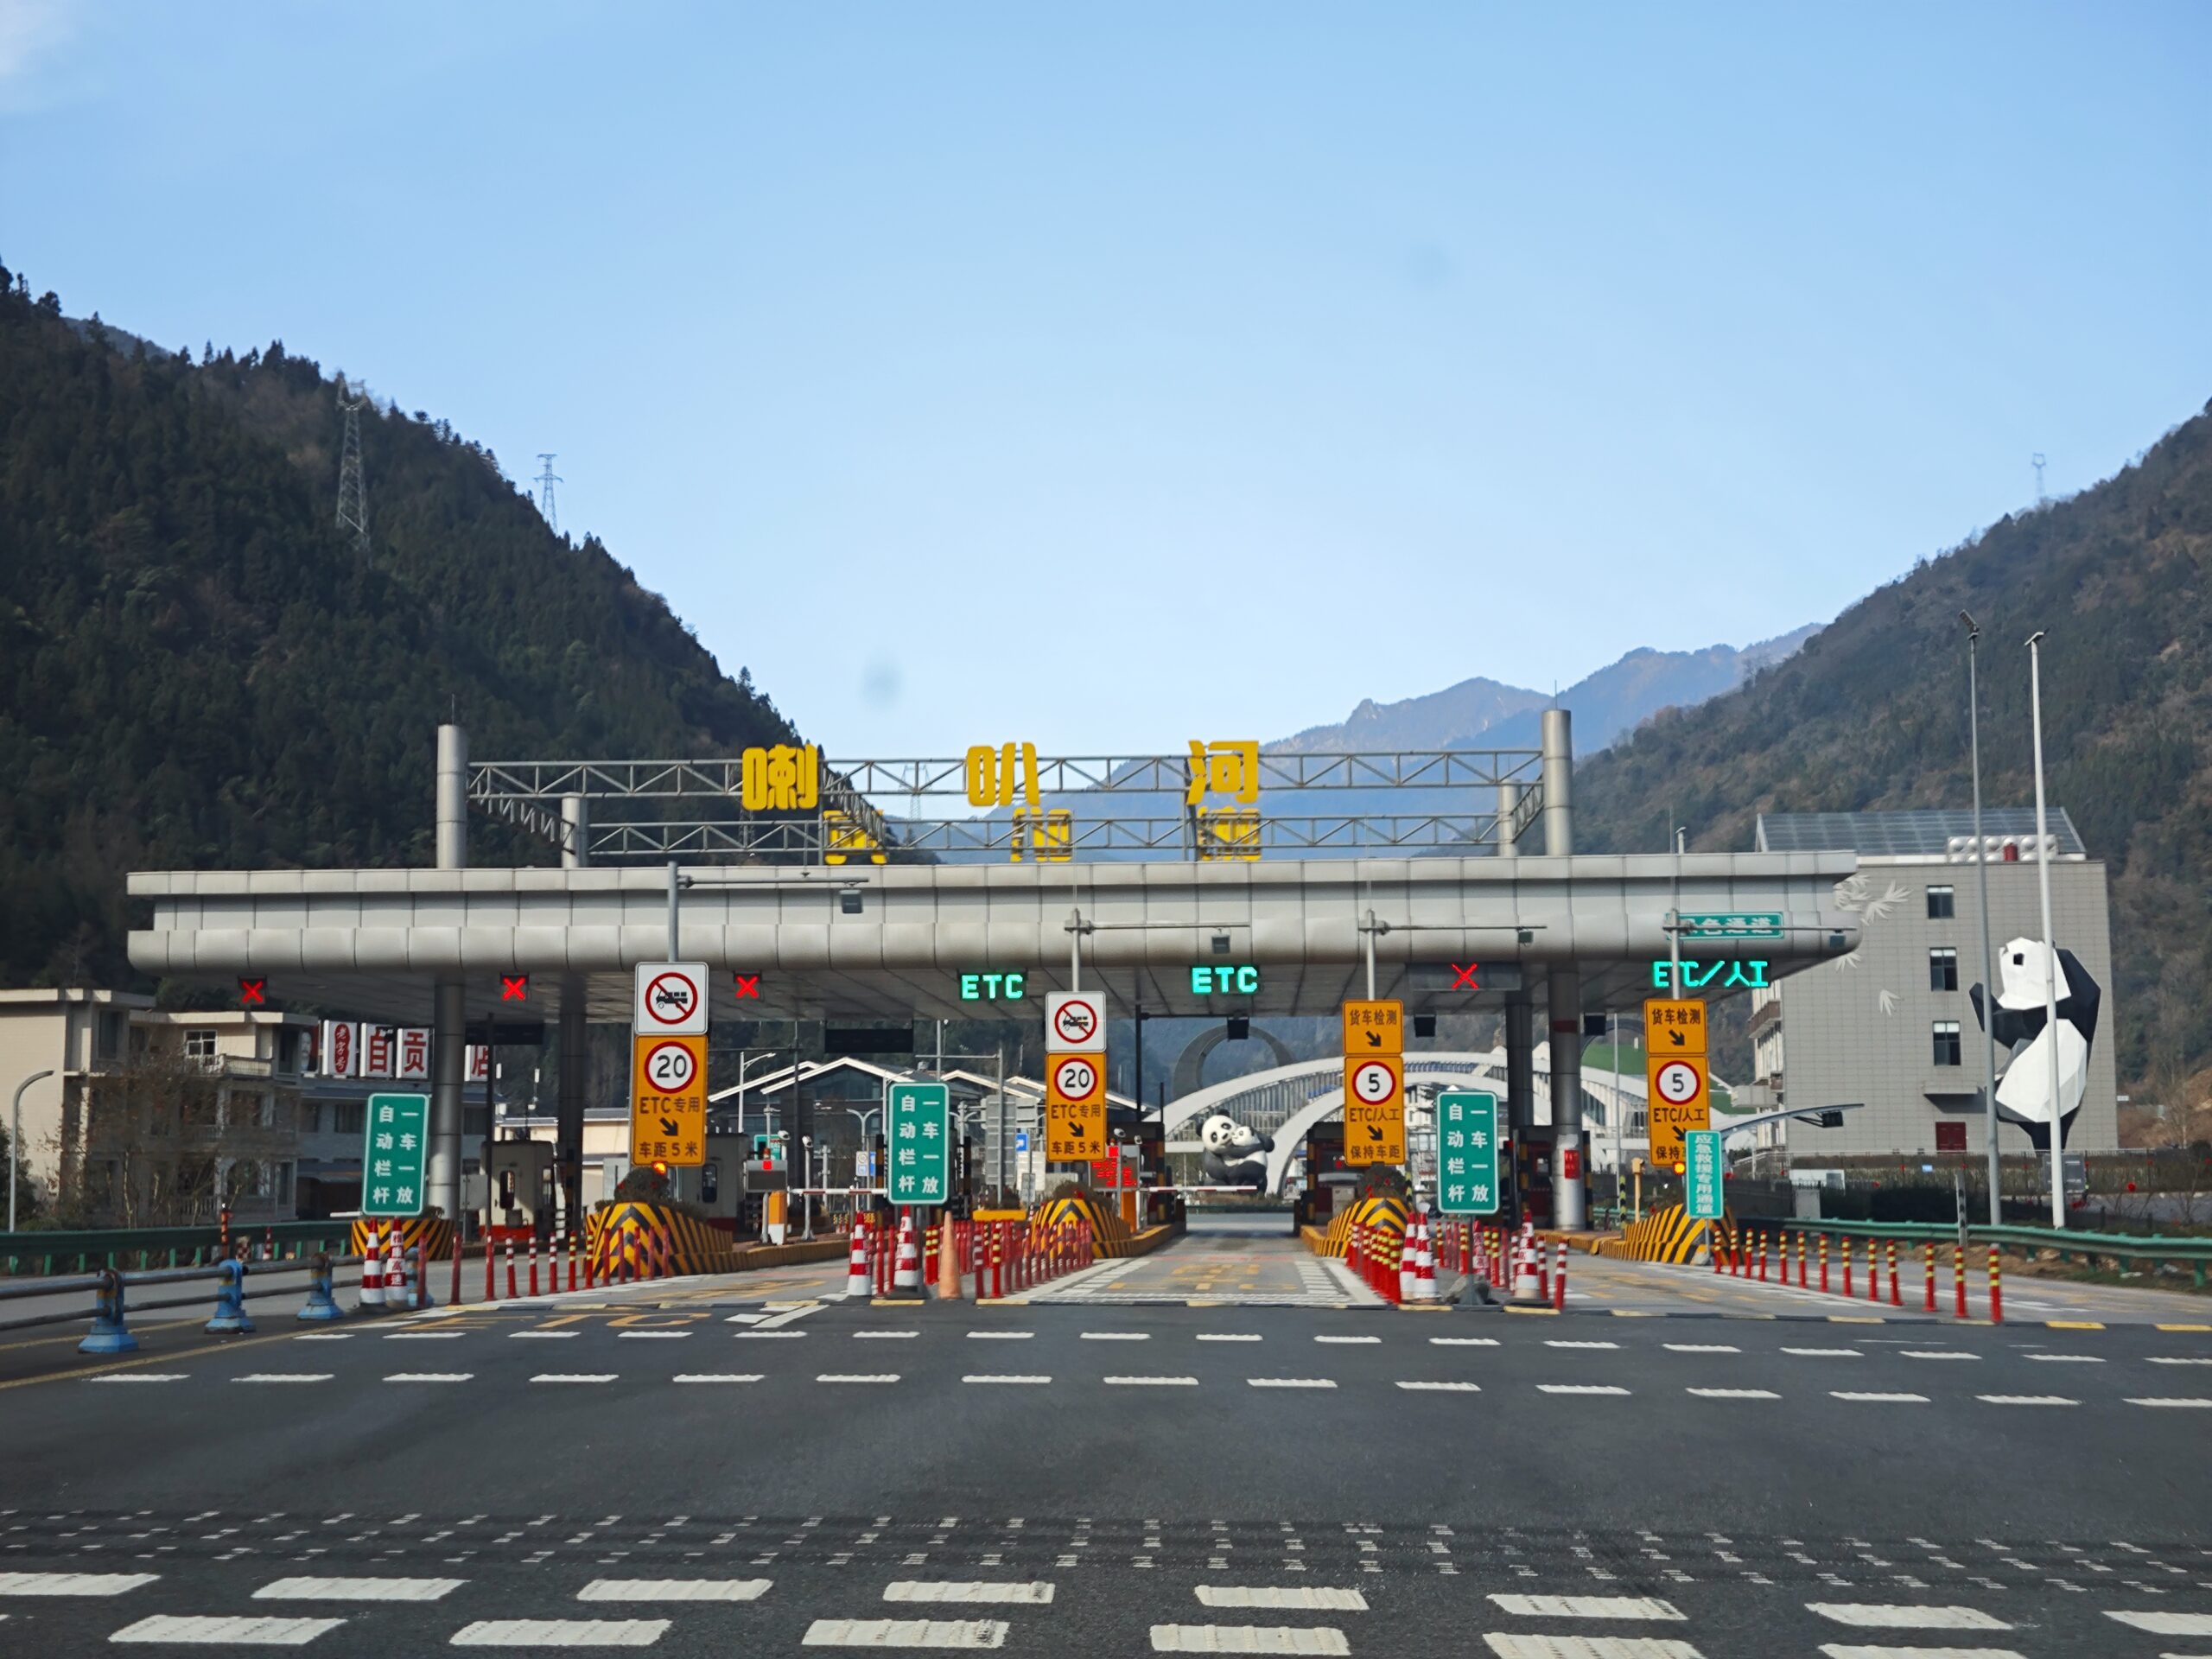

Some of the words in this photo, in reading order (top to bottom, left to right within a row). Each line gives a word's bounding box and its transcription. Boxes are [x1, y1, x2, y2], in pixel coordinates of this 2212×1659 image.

[742, 740, 1259, 810] 喇叭河
[1679, 917, 1773, 935] 色通道
[961, 974, 1024, 1000] ETC
[1192, 966, 1258, 994] ETC
[1350, 1009, 1397, 1027] 货车检测
[1652, 1008, 1700, 1025] 货车检测
[657, 1055, 688, 1078] 20
[1065, 1068, 1090, 1088] 20
[1368, 1073, 1381, 1092] 5
[1672, 1073, 1684, 1092] 5
[639, 1096, 701, 1114] ETC专用
[1051, 1104, 1101, 1119] ETC专用
[1350, 1108, 1400, 1122] ETC/人工
[1653, 1108, 1705, 1122] ETC/人工
[639, 1141, 699, 1158] 车距5米
[898, 1095, 916, 1193] 自动栏杆
[922, 1100, 940, 1194] 一车一放
[1052, 1141, 1101, 1155] 车距5米
[1351, 1145, 1401, 1159] 保持车距
[1446, 1103, 1465, 1203] 自动栏杆
[372, 1105, 394, 1204] 自动栏杆
[396, 1111, 419, 1204] 一车一放
[1471, 1109, 1490, 1203] 一车一放
[399, 1313, 712, 1331] ETC
